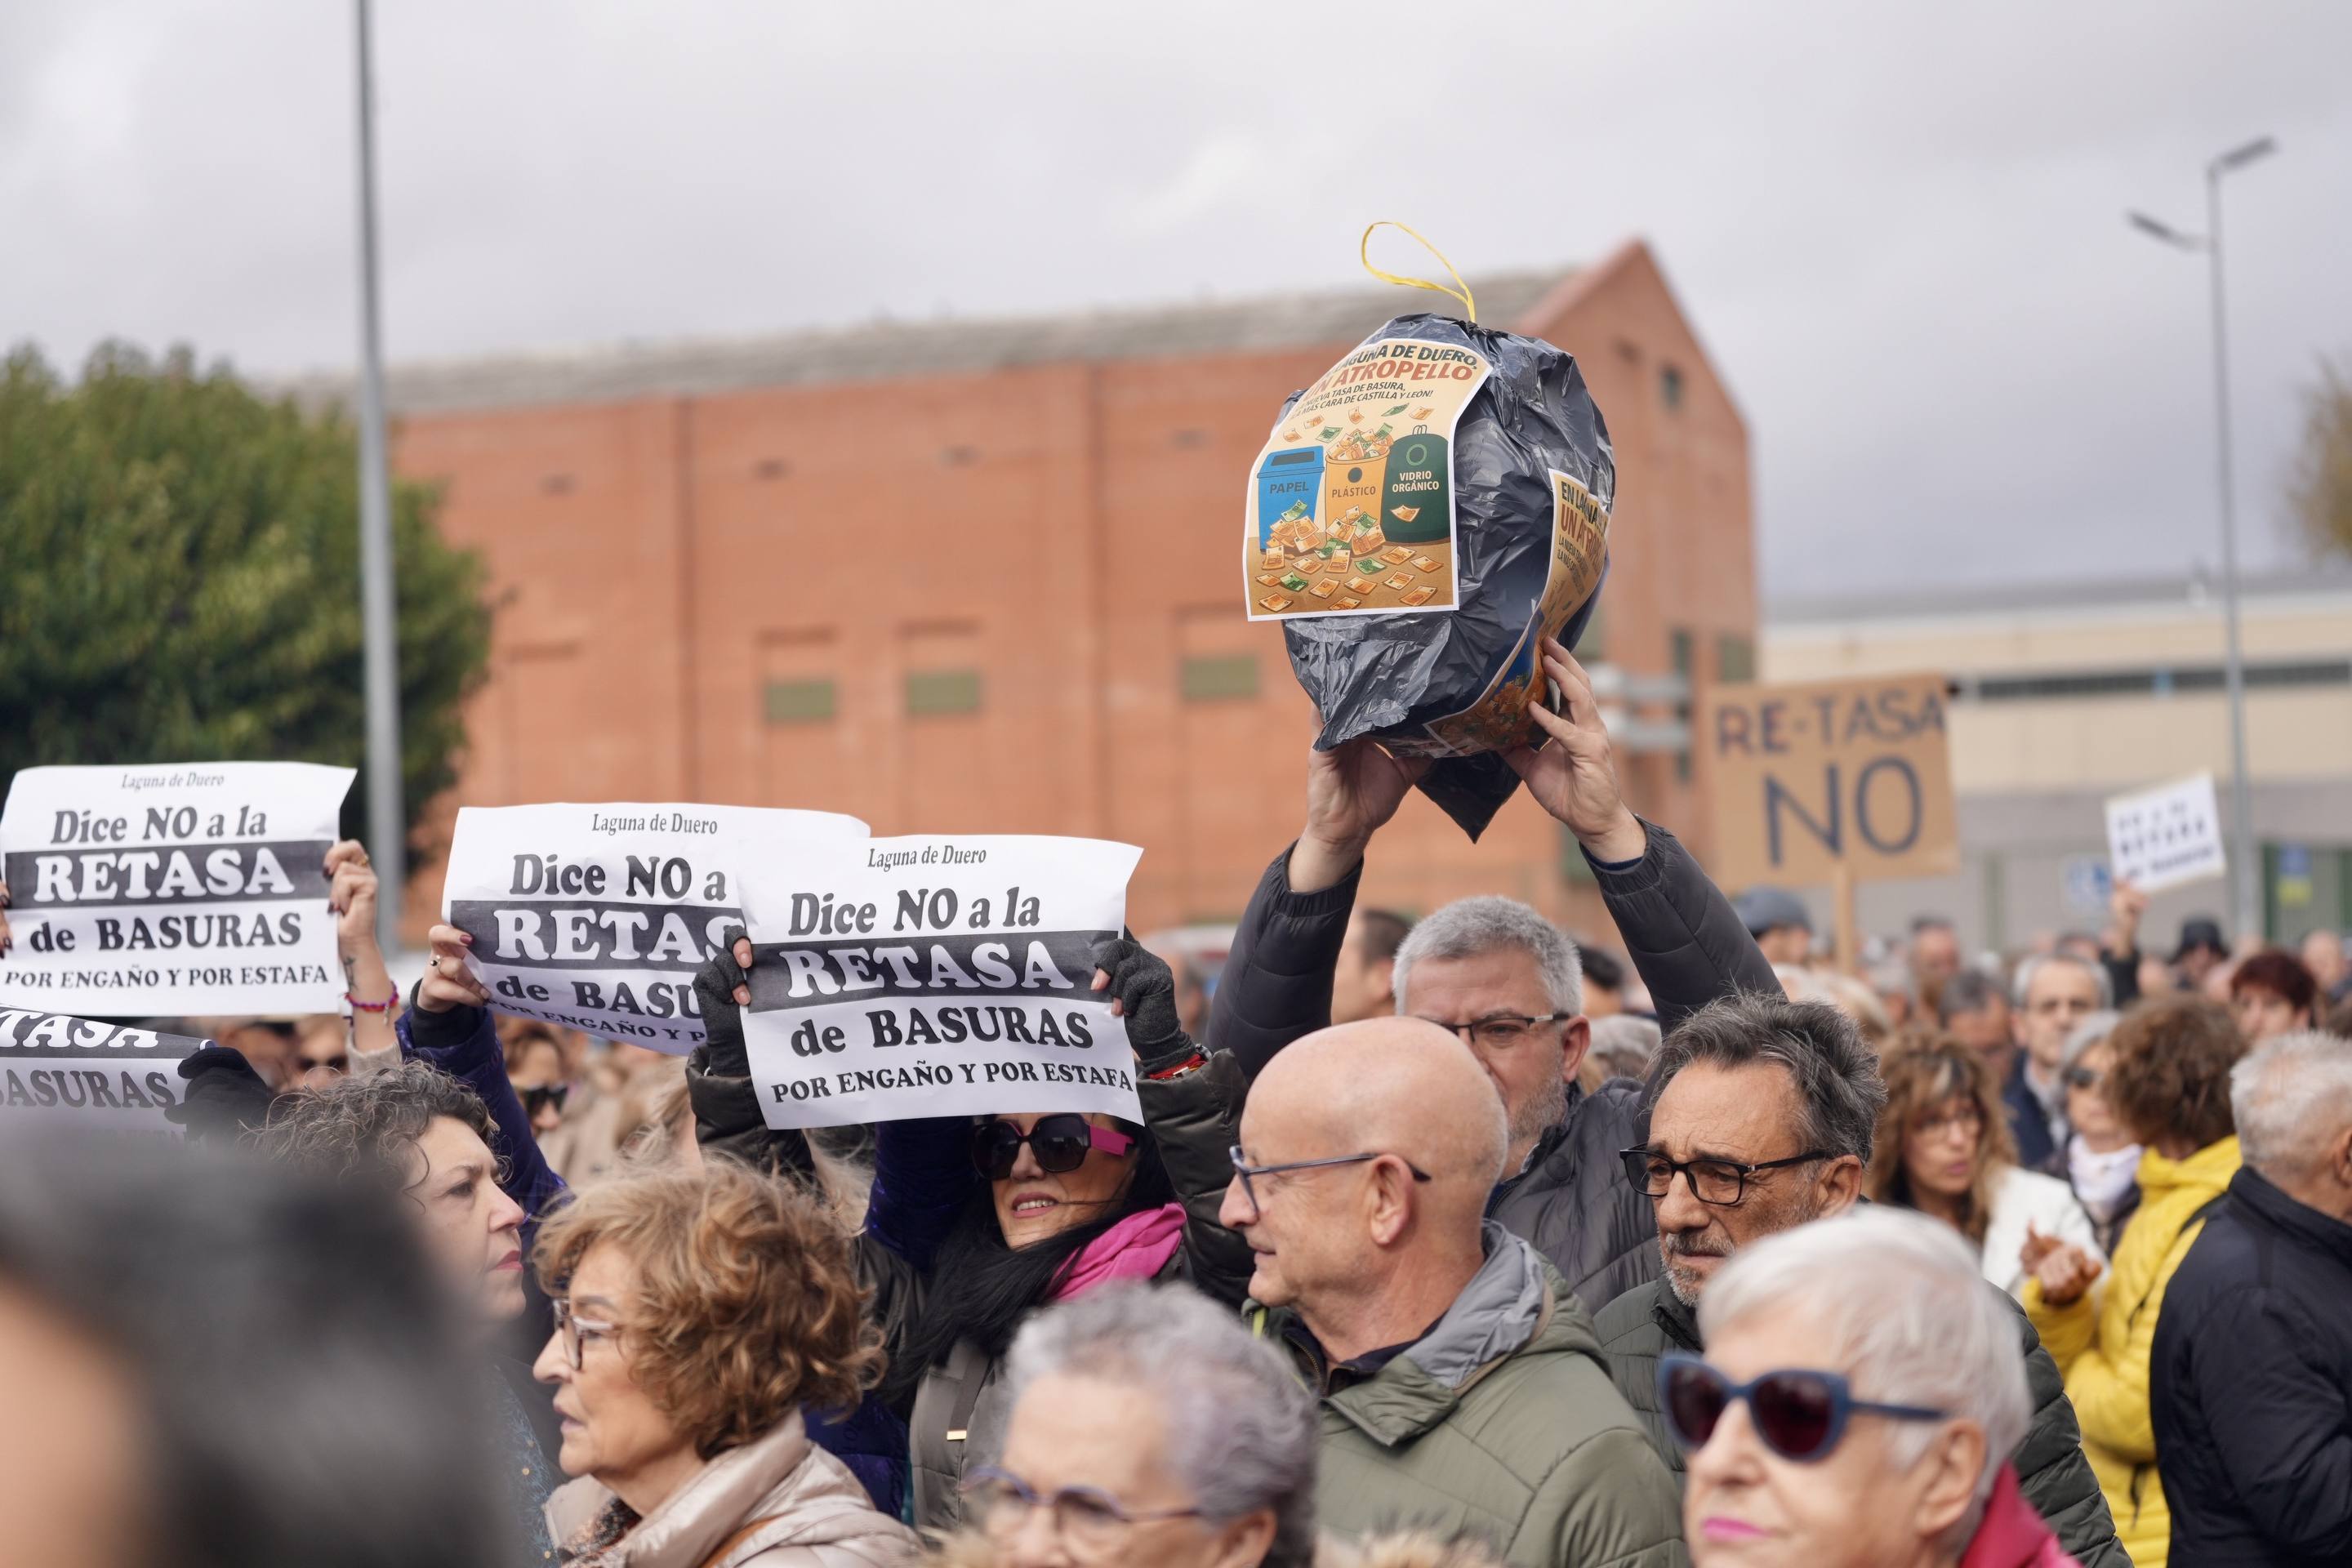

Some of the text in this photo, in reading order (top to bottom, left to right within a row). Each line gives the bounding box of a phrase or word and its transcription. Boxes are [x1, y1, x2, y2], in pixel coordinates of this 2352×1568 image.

[1391, 345, 1417, 358] DE
[1418, 346, 1477, 370] DUERO,
[1333, 359, 1472, 388] ATROPELLO
[1320, 397, 1343, 409] CARA
[1344, 394, 1356, 404] DE
[1357, 391, 1397, 403] CASTILLA
[1332, 388, 1352, 398] TASA
[1353, 385, 1365, 393] DE
[1269, 481, 1310, 494] PAPEL
[1399, 470, 1432, 482] VIDRIO
[1331, 486, 1376, 498] PLÁSTICO
[1561, 481, 1575, 505] EN
[1561, 503, 1577, 538] UN
[122, 773, 225, 791] Laguna de Duero
[51, 805, 267, 844] Dice NO a la
[591, 813, 718, 836] Laguna de Duero
[1765, 755, 1922, 868] NO
[867, 845, 987, 872] Laguna de Duero
[33, 847, 296, 902] RETASA
[509, 853, 727, 902] Dice NO a
[788, 886, 1040, 937] Dice NO a la
[30, 912, 302, 953] de BASURAS
[5, 964, 328, 988] POR ENGAÑO Y POR ESTAFA
[779, 940, 1074, 999] RETASA
[496, 975, 550, 1002] de
[541, 1011, 656, 1038] ENGAÑO
[662, 1028, 680, 1040] Y
[791, 1006, 1094, 1058] de BASURAS
[0, 1069, 176, 1108] ASURAS
[771, 1060, 1134, 1102] POR ENGAÑO Y POR ESTAFA
